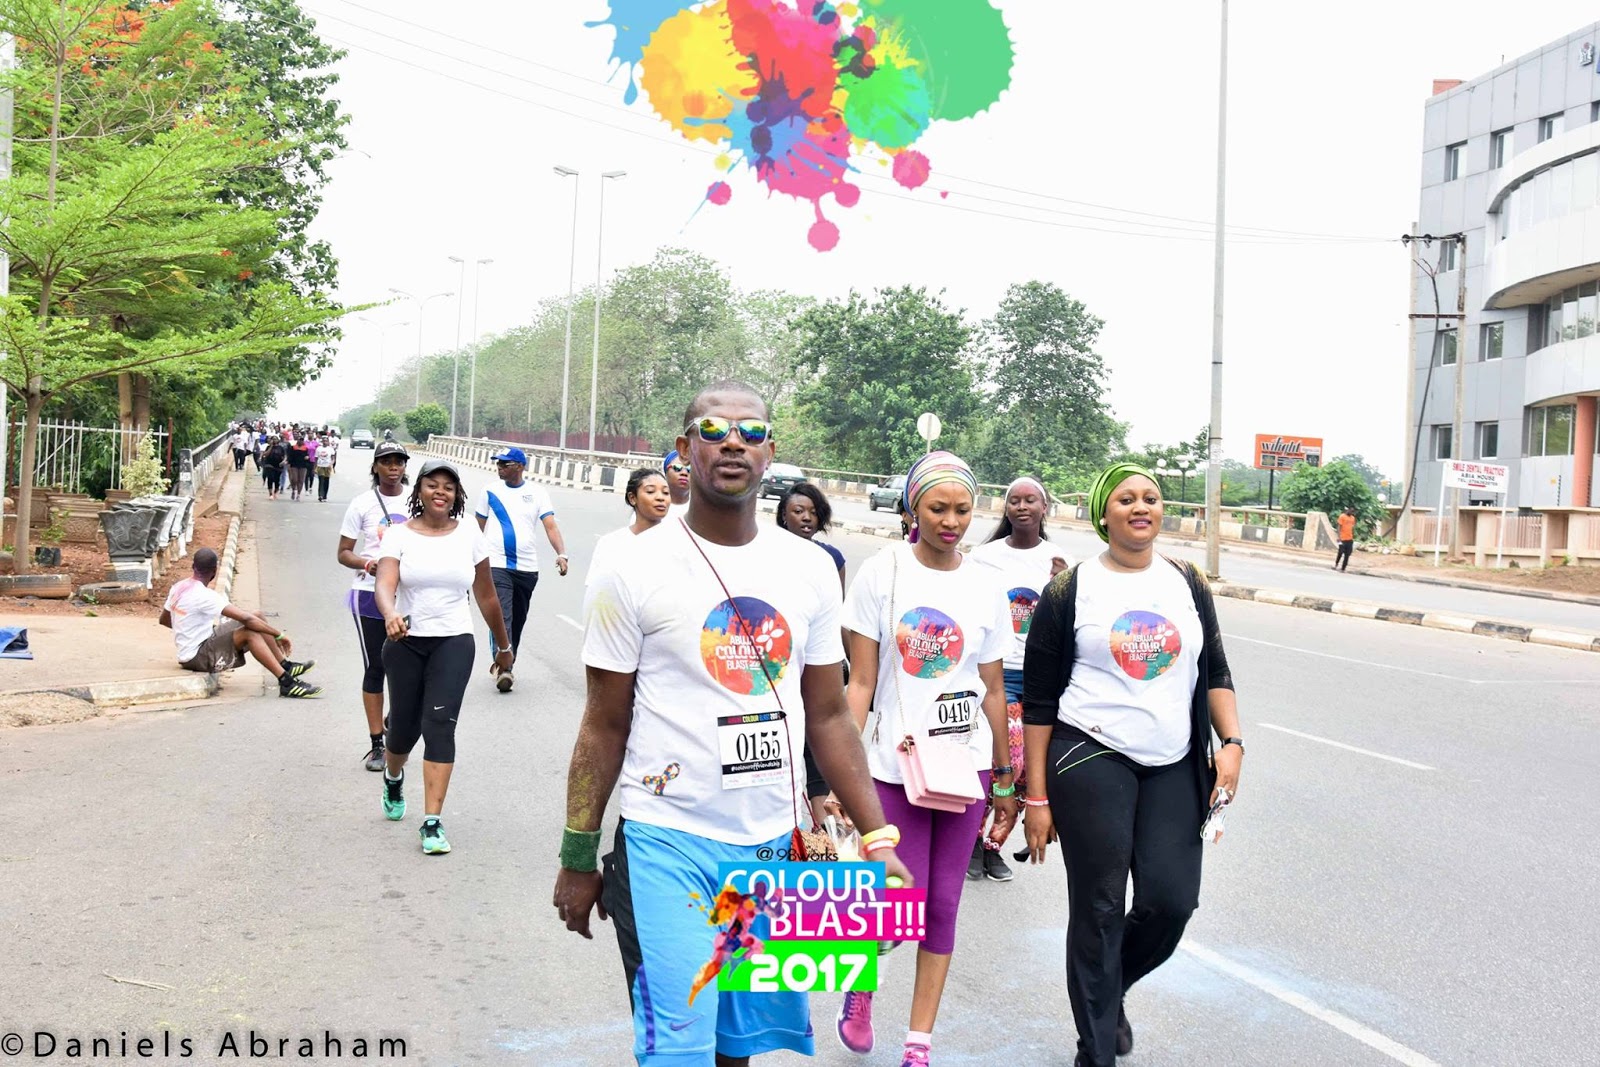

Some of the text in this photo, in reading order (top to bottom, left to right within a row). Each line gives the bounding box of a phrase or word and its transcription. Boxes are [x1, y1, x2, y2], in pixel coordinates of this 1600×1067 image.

[1466, 464, 1482, 473] DENTAL
[1484, 466, 1505, 476] PRACTICE
[905, 636, 941, 654] COLOUR
[1121, 642, 1161, 653] COLOUR
[715, 645, 766, 660] COLOUR
[908, 648, 926, 660] BLAST
[1129, 653, 1147, 661] BLAST
[726, 659, 749, 670] BLAST
[938, 699, 971, 724] 0419
[736, 730, 781, 762] 0155
